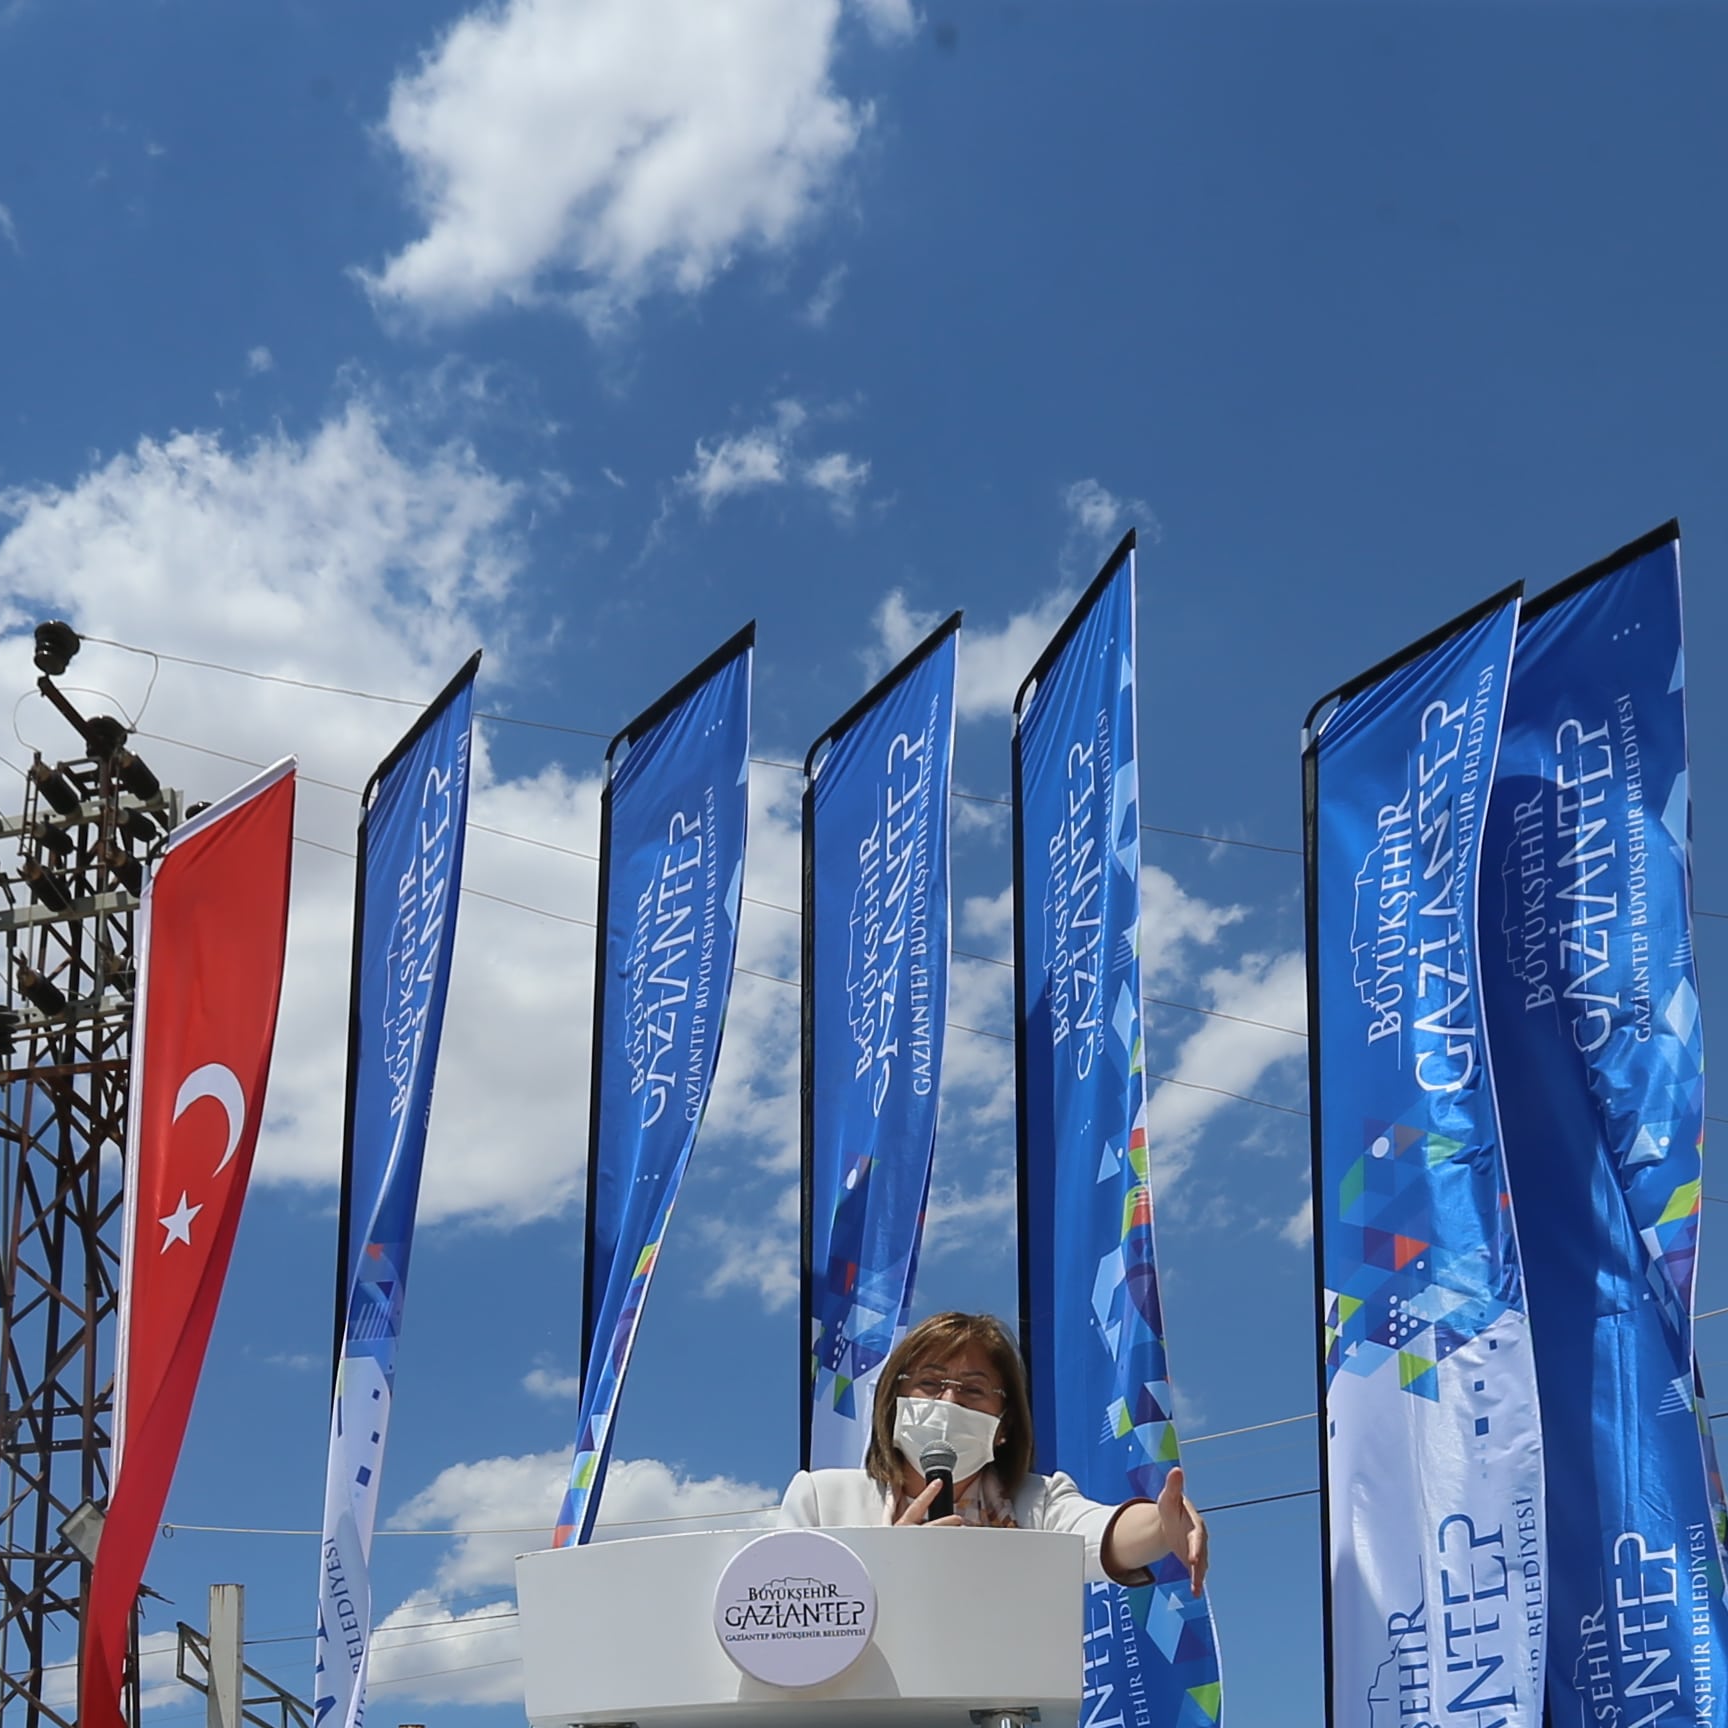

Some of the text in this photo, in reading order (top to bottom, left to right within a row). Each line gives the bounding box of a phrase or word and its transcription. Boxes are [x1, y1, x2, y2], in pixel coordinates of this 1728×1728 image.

[1463, 664, 1494, 783] BELEDİYESİ
[641, 810, 702, 1130] GAZİANTEP
[684, 785, 717, 1123] GAZİANTEP BÜYÜKŞEHİR BELEDİYESİ
[855, 821, 882, 1081] BÜYÜKŞEHİR
[1049, 821, 1070, 1046] BÜYÜKŞEHİR
[1068, 739, 1103, 1081] GAZİANTEP
[1368, 788, 1414, 1047] BÜYÜKŞEHİR
[1514, 788, 1554, 1014] BÜYÜKŞEHİR
[1549, 718, 1621, 1054] GAZİANTEP
[1617, 693, 1651, 1043] GAZİANTEP BÜYÜKŞEHİR BELEDİYESİ
[390, 857, 419, 1120] BÜYÜKŞEHİR
[631, 879, 655, 1095] BÜYÜKŞEHİR
[910, 965, 932, 1097] GAZİANTEP
[725, 1600, 865, 1630] GAZİANTEP
[725, 1627, 866, 1642] GAZİANTEP BÜYÜKŞEHİR BELEDİYESİ
[748, 1583, 838, 1602] BÜYÜKŞEHİR
[1685, 1522, 1710, 1636] BELEDİYESİ
